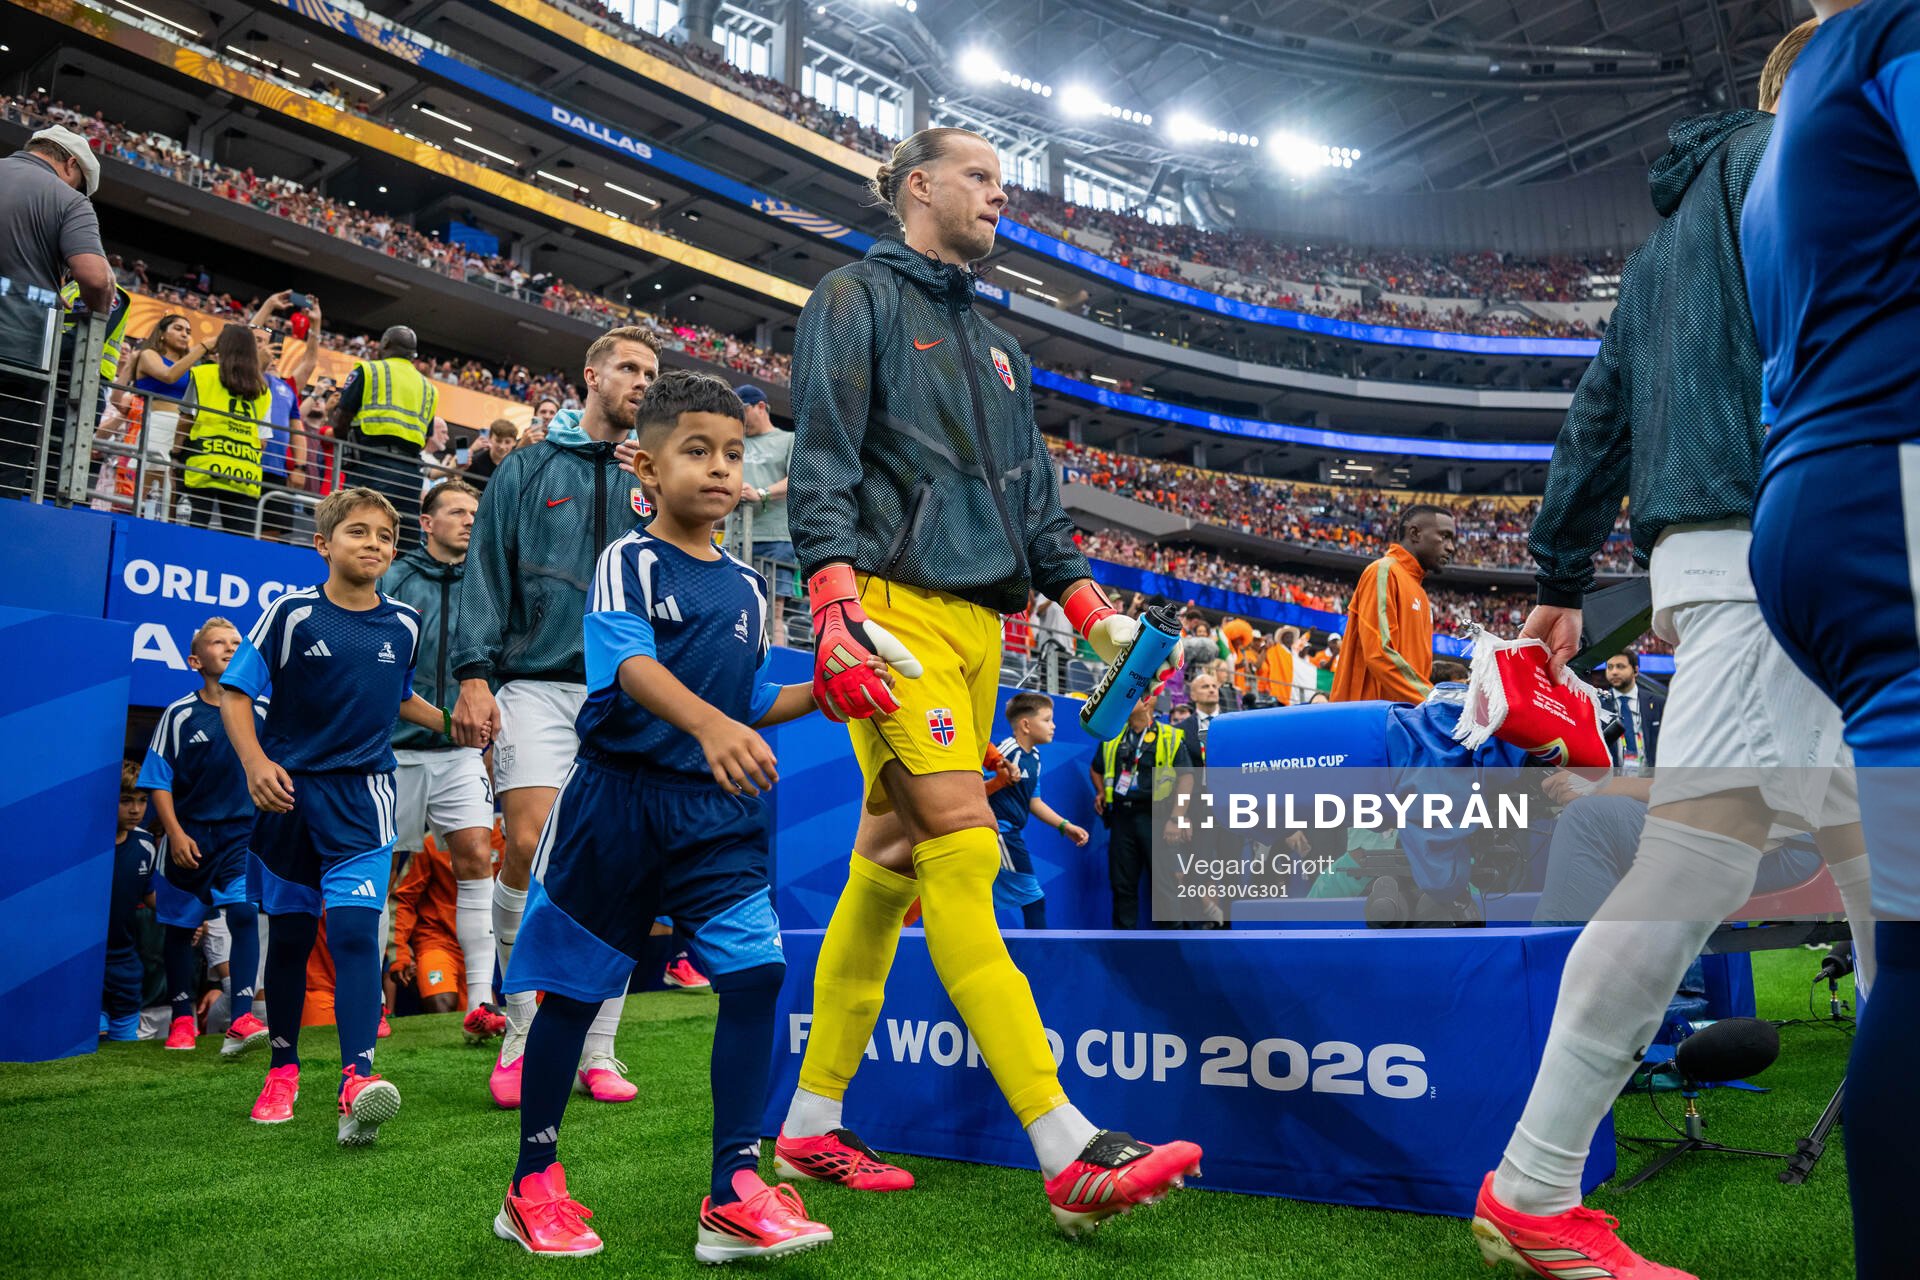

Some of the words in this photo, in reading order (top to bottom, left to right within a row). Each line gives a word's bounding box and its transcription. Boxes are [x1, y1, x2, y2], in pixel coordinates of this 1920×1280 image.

[551, 106, 653, 159] DALLAS
[123, 559, 250, 608] ORLD
[1241, 761, 1269, 774] FIFA
[1269, 757, 1316, 771] WORLD
[1075, 1028, 1188, 1082] CUP
[1199, 1035, 1428, 1099] 2026
